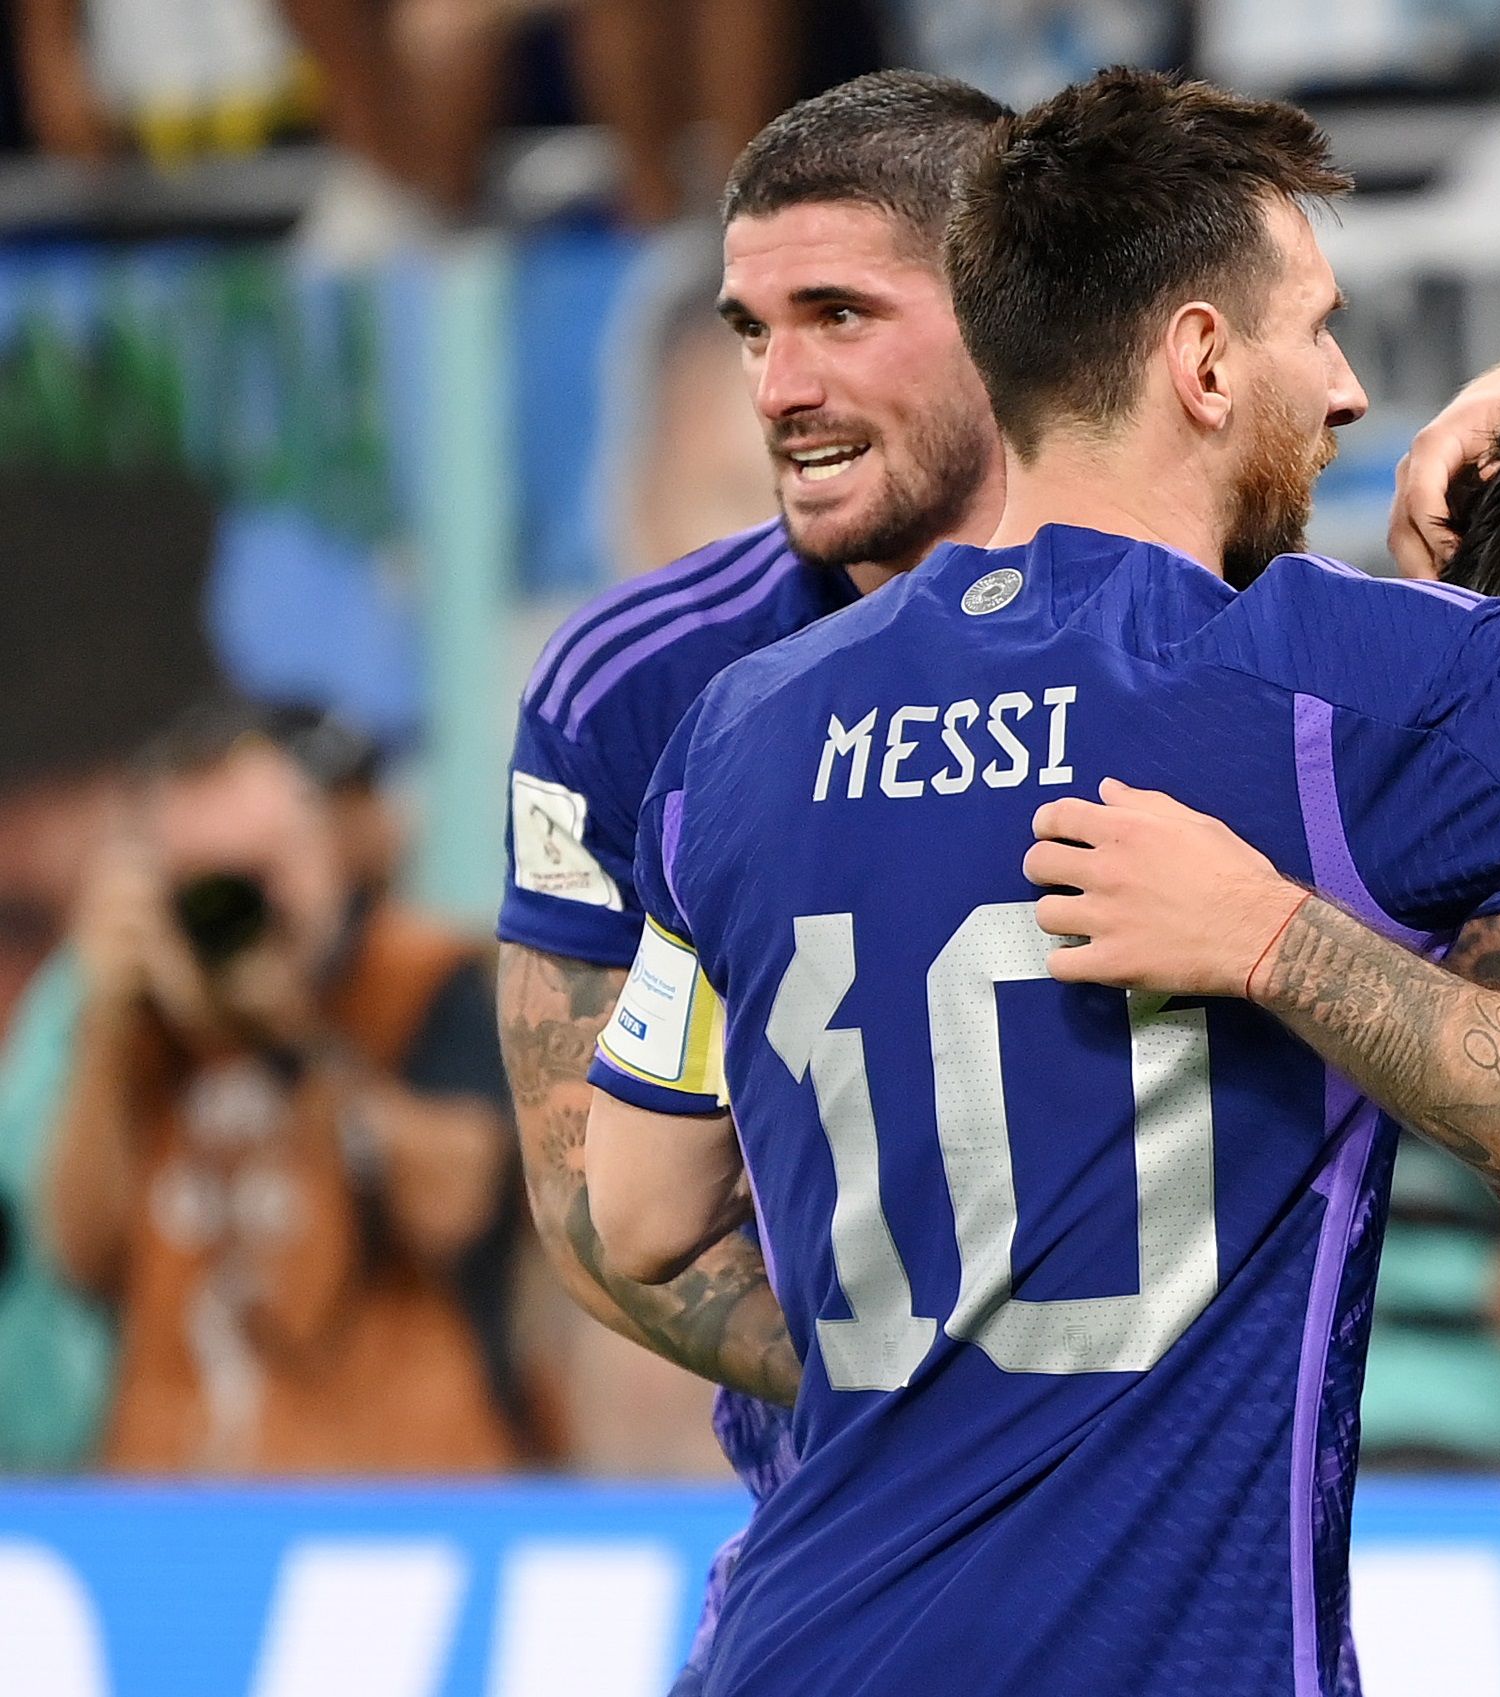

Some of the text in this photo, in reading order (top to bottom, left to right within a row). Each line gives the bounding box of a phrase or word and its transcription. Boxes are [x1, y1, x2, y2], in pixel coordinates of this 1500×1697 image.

[813, 685, 1078, 802] MESSI
[619, 1009, 643, 1037] FIFA
[764, 901, 1218, 1391] 10
